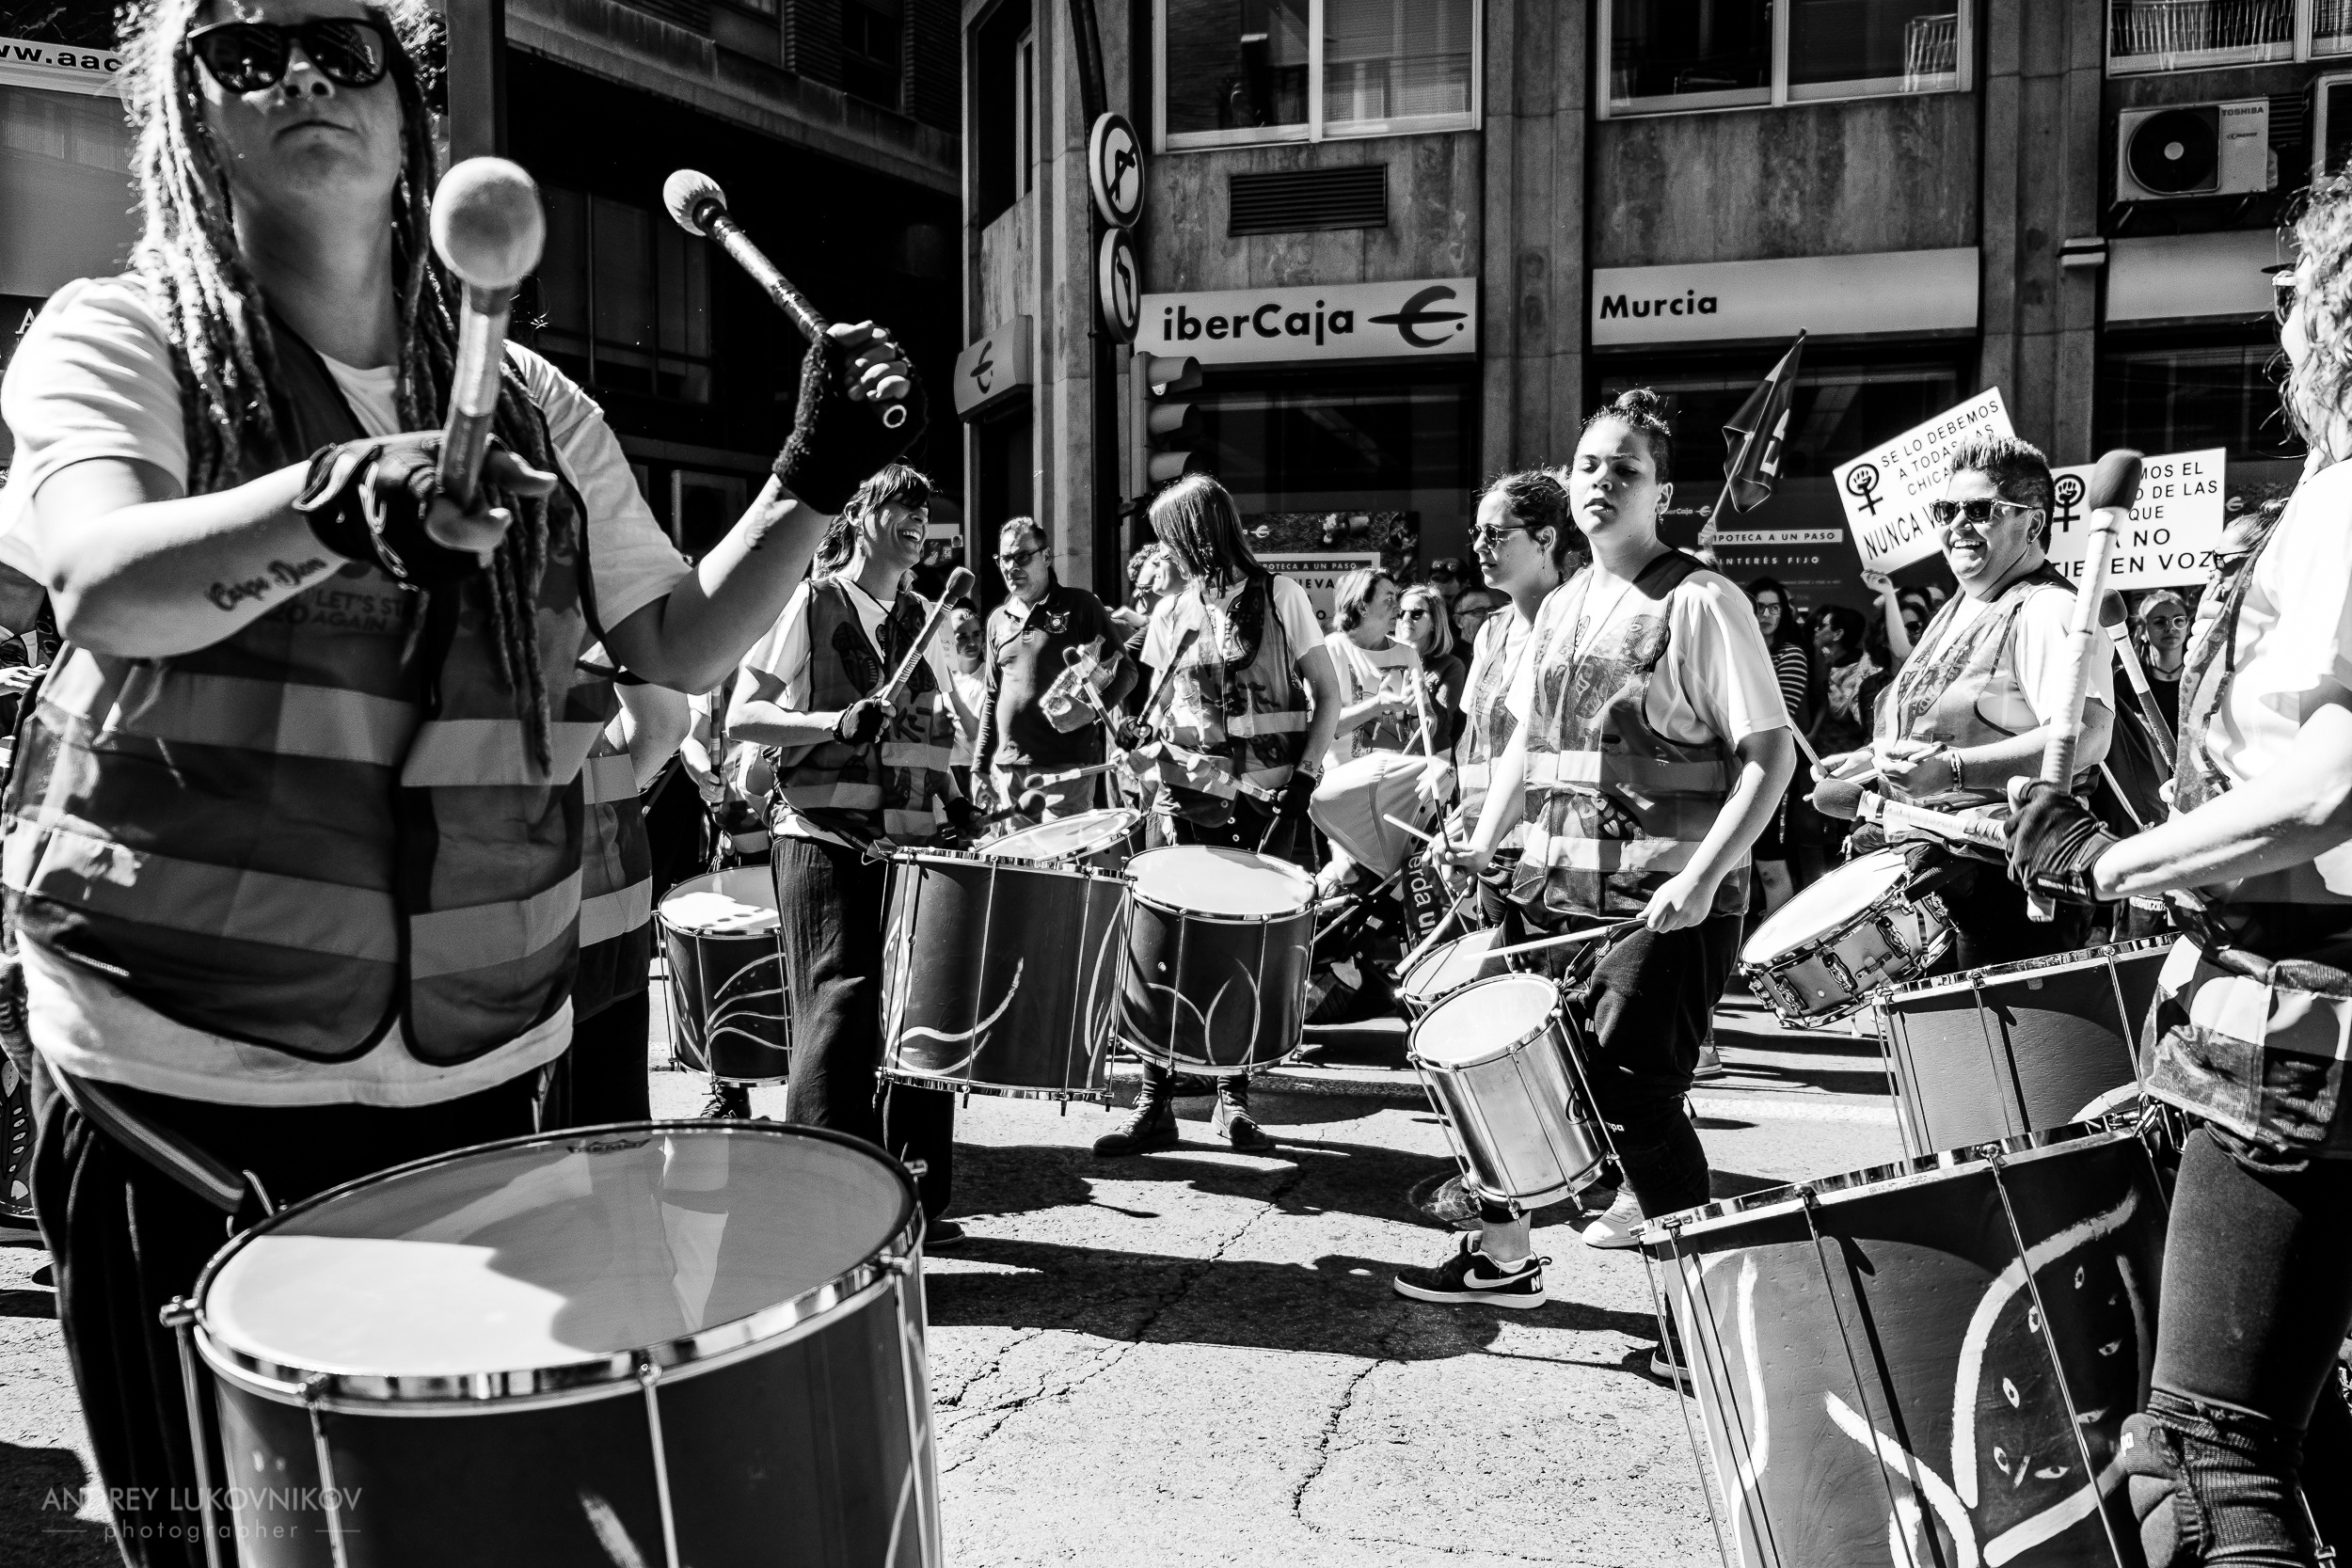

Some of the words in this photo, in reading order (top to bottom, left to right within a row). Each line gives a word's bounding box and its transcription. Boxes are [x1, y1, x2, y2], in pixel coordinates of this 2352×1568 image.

[2220, 106, 2265, 117] TOSHIBA
[1599, 289, 1718, 320] Murcia
[1163, 299, 1355, 346] iberCaja
[1881, 450, 1899, 468] SE
[1903, 438, 1923, 457] LO
[1927, 400, 1999, 445] DEBEMOS
[1899, 467, 1909, 481] A
[2141, 464, 2174, 481] MOS
[2183, 461, 2204, 477] EL
[1907, 467, 1951, 496] CHICA
[2153, 483, 2174, 499] DE
[2184, 480, 2217, 497] LAS
[2128, 505, 2165, 522] QUE
[1713, 533, 1762, 543] IPOTECA
[1769, 533, 1776, 542] A
[1781, 532, 1798, 542] UN
[1804, 531, 1836, 541] PASO
[1863, 512, 1924, 561] NUNCA
[2133, 528, 2170, 547] NO
[1719, 555, 1778, 565] INTERÉS
[2051, 555, 2145, 578] IEEN
[2158, 550, 2213, 570] VOZ
